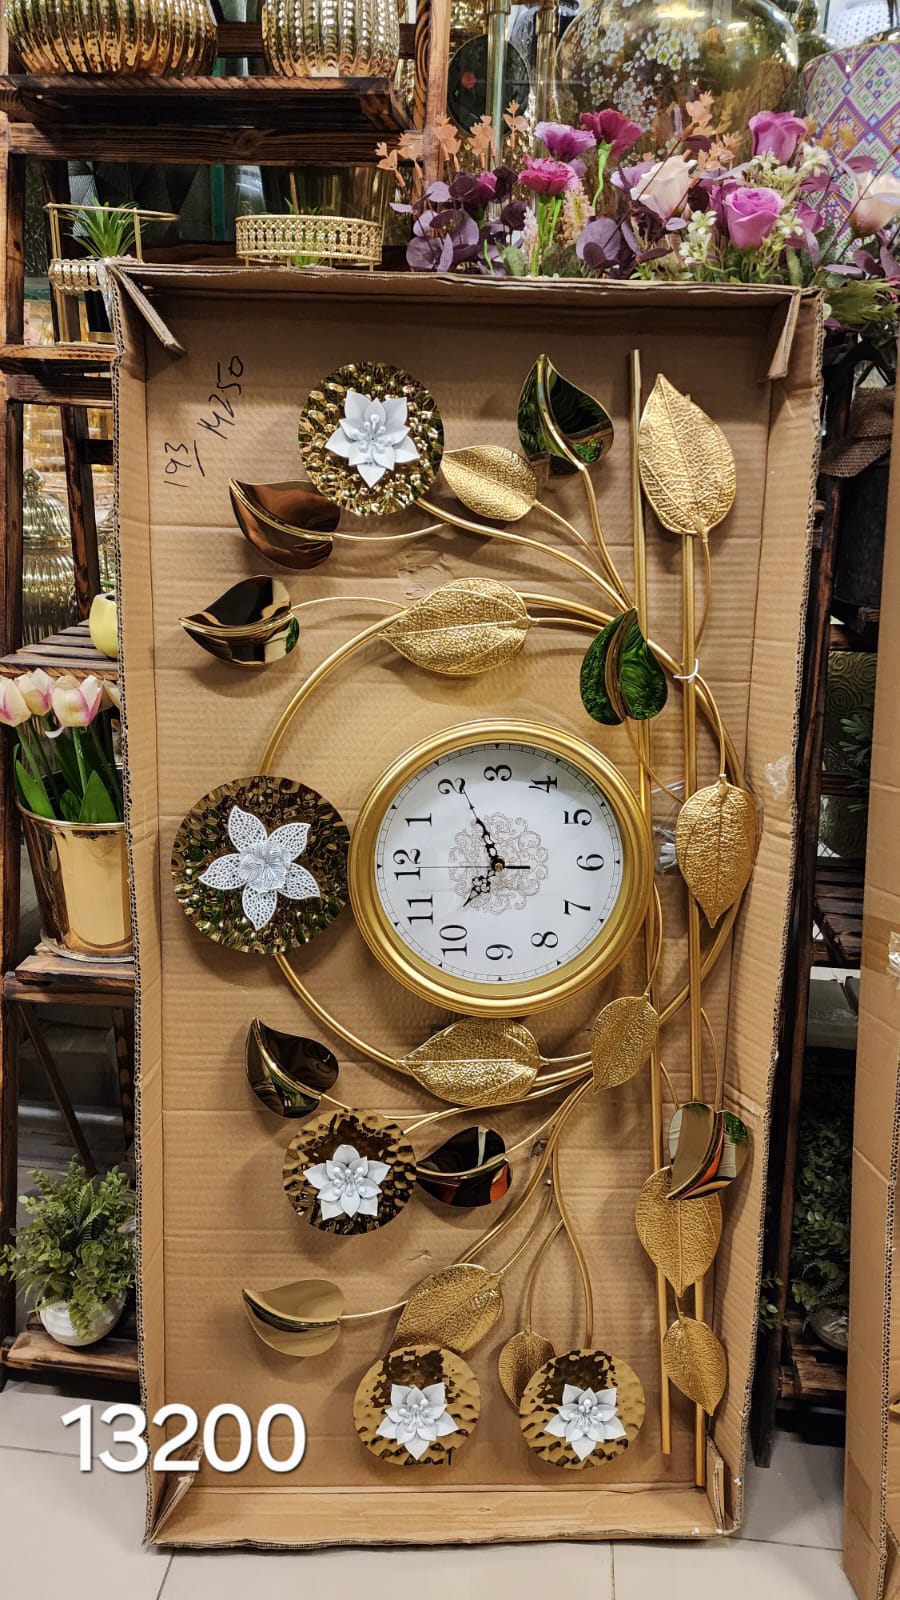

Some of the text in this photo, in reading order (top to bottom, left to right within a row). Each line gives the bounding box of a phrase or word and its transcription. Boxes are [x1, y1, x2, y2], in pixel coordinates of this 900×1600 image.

[483, 764, 512, 782] 3
[437, 777, 466, 795] 2
[528, 775, 558, 794] 4
[405, 812, 432, 828] 1
[564, 808, 593, 827] 5
[392, 848, 421, 881] 12
[576, 853, 605, 872] 6
[406, 893, 434, 925] 11
[564, 899, 591, 916] 7
[439, 924, 468, 957] 10
[530, 930, 559, 949] 8
[485, 944, 513, 961] 9
